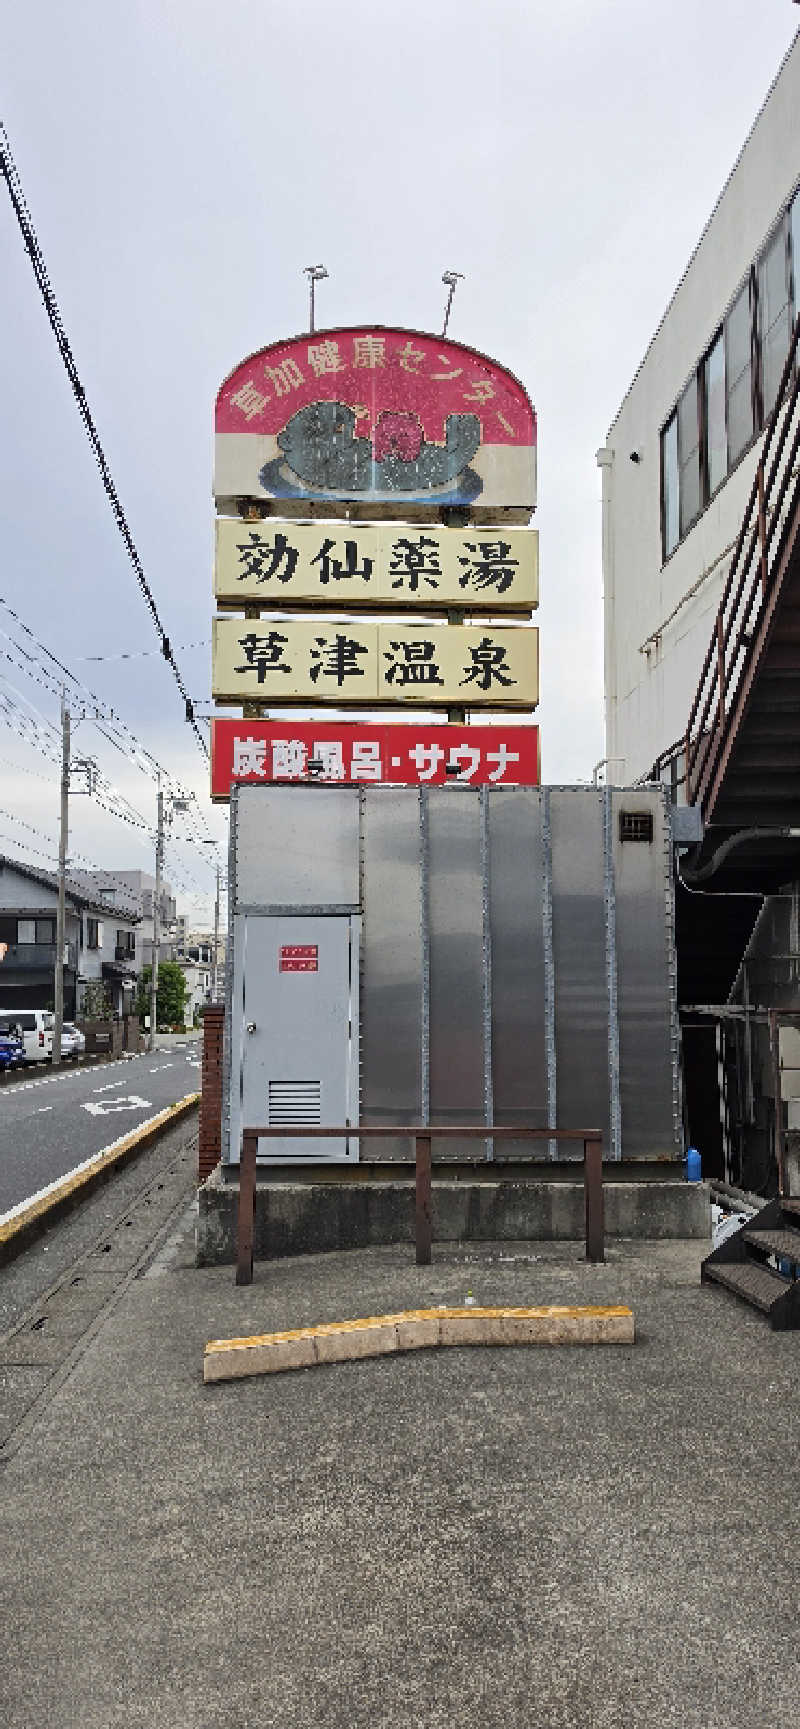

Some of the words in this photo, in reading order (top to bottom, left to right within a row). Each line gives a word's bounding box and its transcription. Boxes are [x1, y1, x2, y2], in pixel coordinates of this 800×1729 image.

[230, 335, 515, 437] 草加健康センター
[236, 532, 519, 593] 効仙薬湯
[234, 632, 517, 690] 草津温泉
